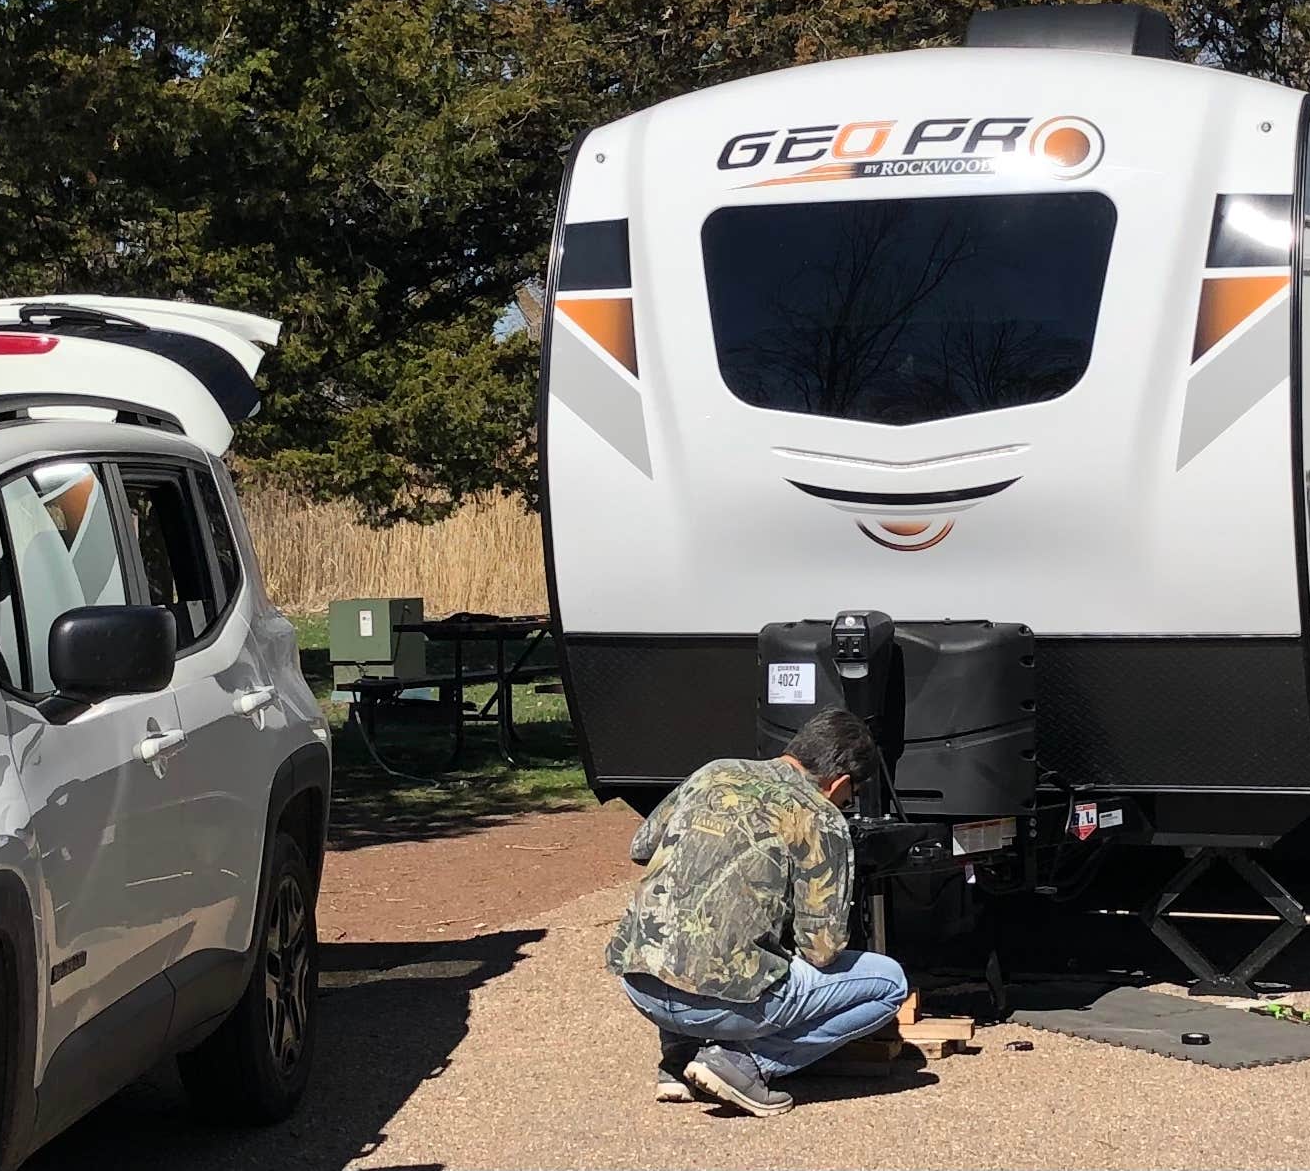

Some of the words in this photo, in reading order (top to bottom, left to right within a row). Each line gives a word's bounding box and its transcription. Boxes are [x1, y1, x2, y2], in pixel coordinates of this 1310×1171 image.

[717, 120, 898, 170] GEO
[864, 164, 880, 175] BY
[778, 673, 800, 687] 4027
